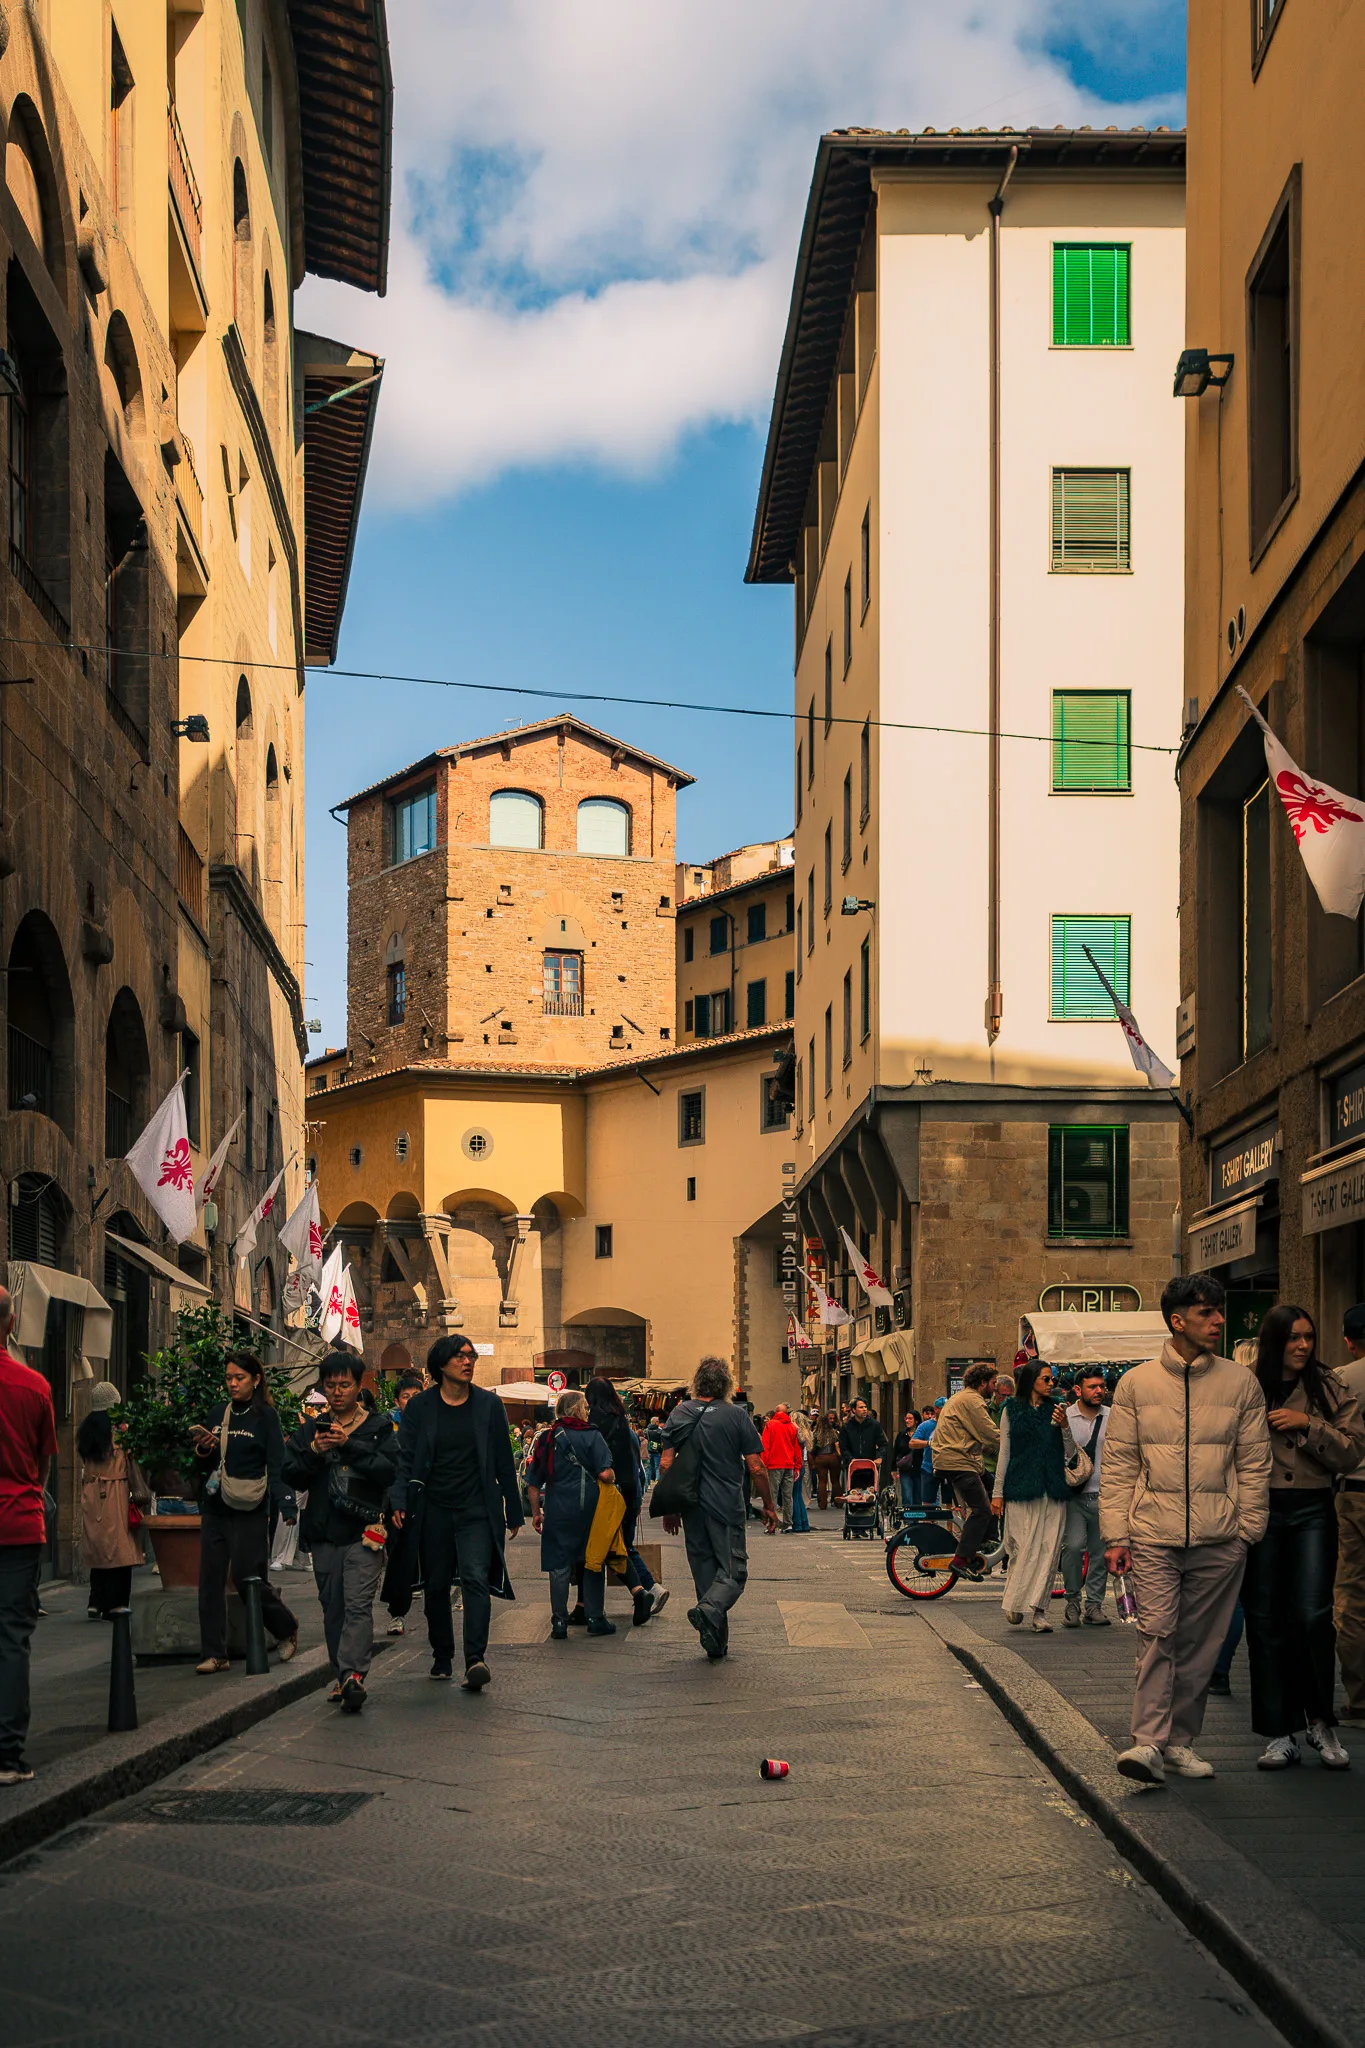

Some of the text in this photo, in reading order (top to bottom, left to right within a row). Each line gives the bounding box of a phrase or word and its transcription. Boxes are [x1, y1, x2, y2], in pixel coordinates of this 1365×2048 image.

[1222, 1137, 1274, 1189] T-SHIRT GALLERY
[1311, 1174, 1365, 1219] T-SHIRT GALLE
[1200, 1222, 1243, 1261] T-SHIRT GALLERY
[807, 1237, 822, 1318] SNACK
[211, 1425, 254, 1438] Cmpion
